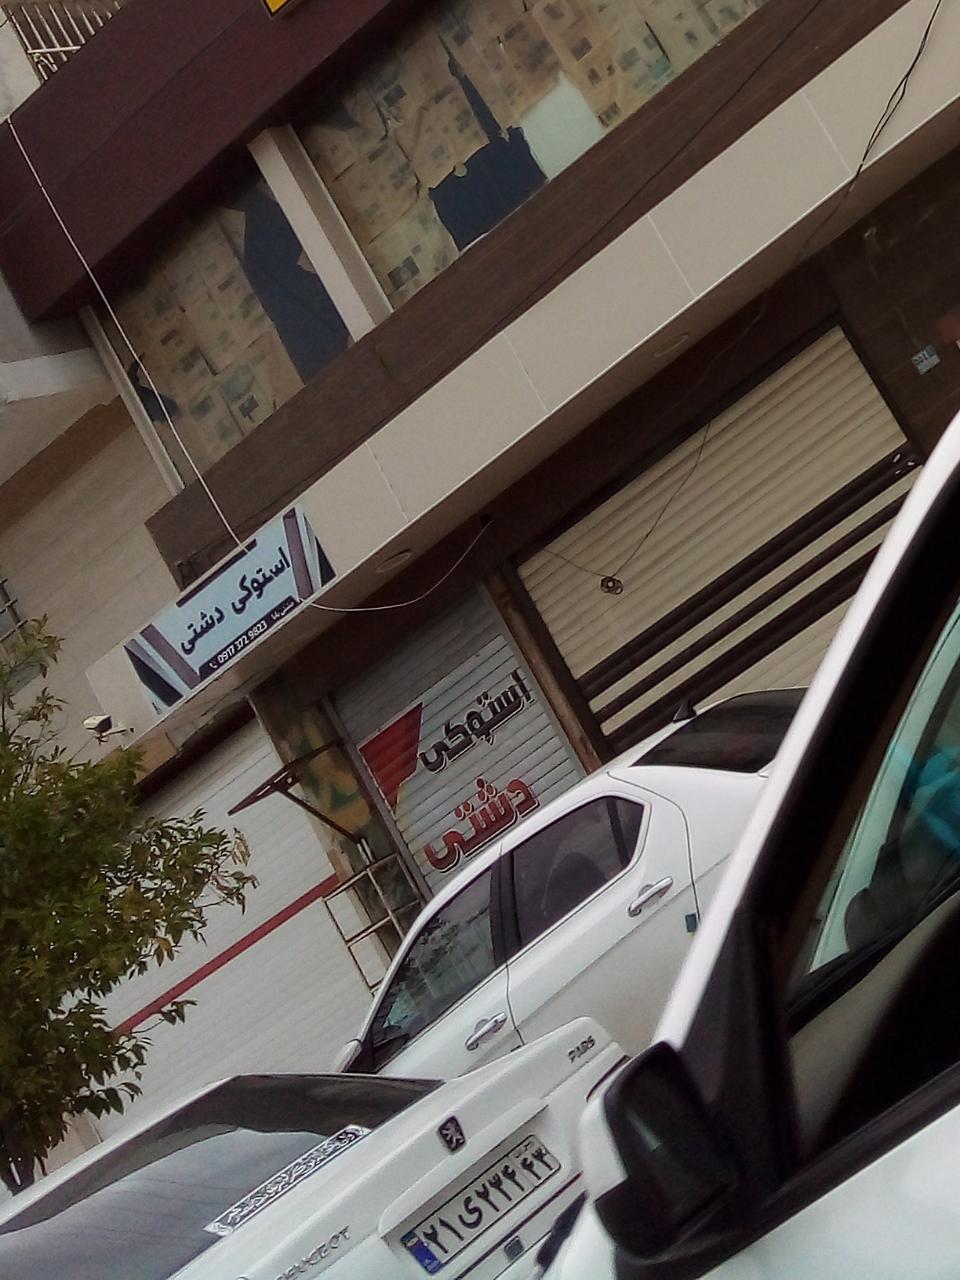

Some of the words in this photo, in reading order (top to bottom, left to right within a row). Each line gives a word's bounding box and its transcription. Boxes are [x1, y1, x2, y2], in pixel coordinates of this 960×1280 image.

[231, 547, 291, 614] استوکی
[180, 606, 225, 655] دشتی
[418, 669, 534, 773] استوکی
[424, 775, 539, 873] دشتی
